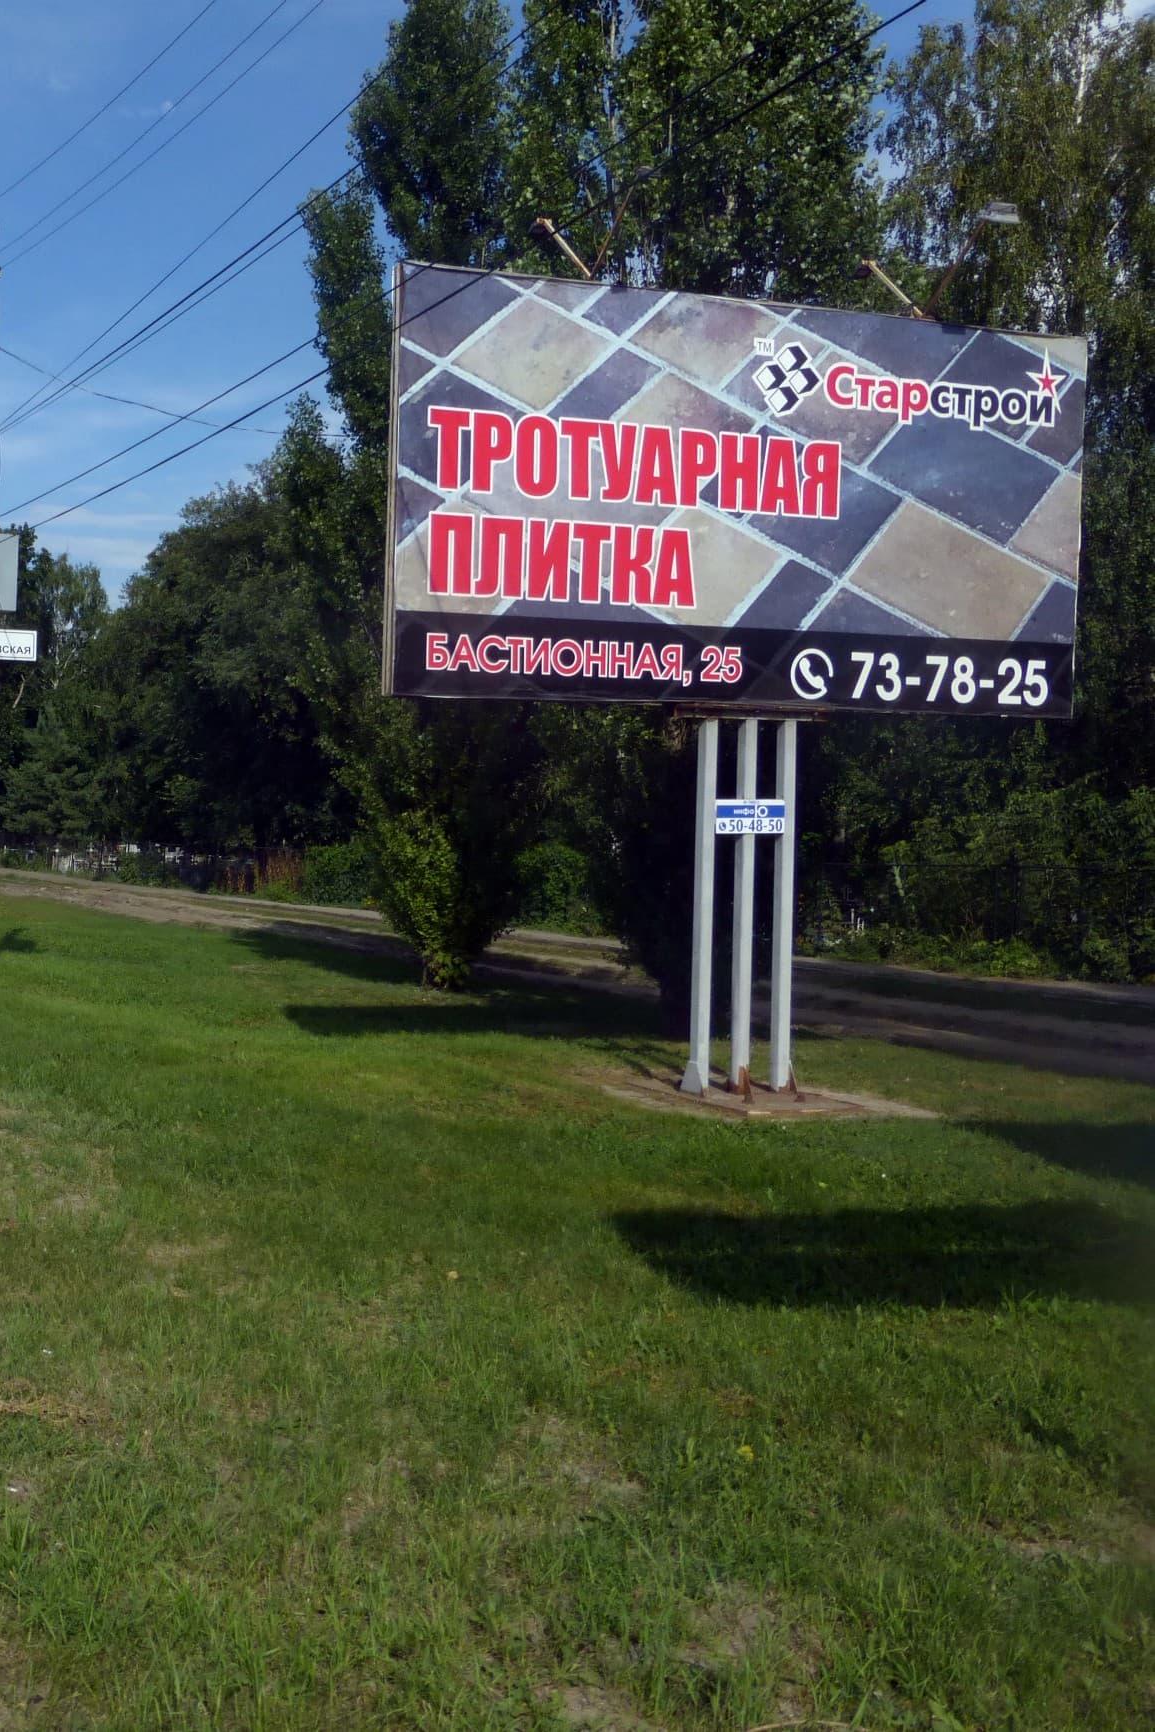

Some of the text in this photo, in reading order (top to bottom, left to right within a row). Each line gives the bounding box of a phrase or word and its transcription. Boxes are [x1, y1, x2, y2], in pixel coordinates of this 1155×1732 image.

[429, 407, 840, 519] ТРОТУАРНАЯ
[428, 512, 697, 608] ПЛИТКА
[426, 633, 744, 688] БАСТИОННАЯ, 25
[850, 652, 1049, 707] 73-78-25
[728, 819, 783, 832] 50-48-50
